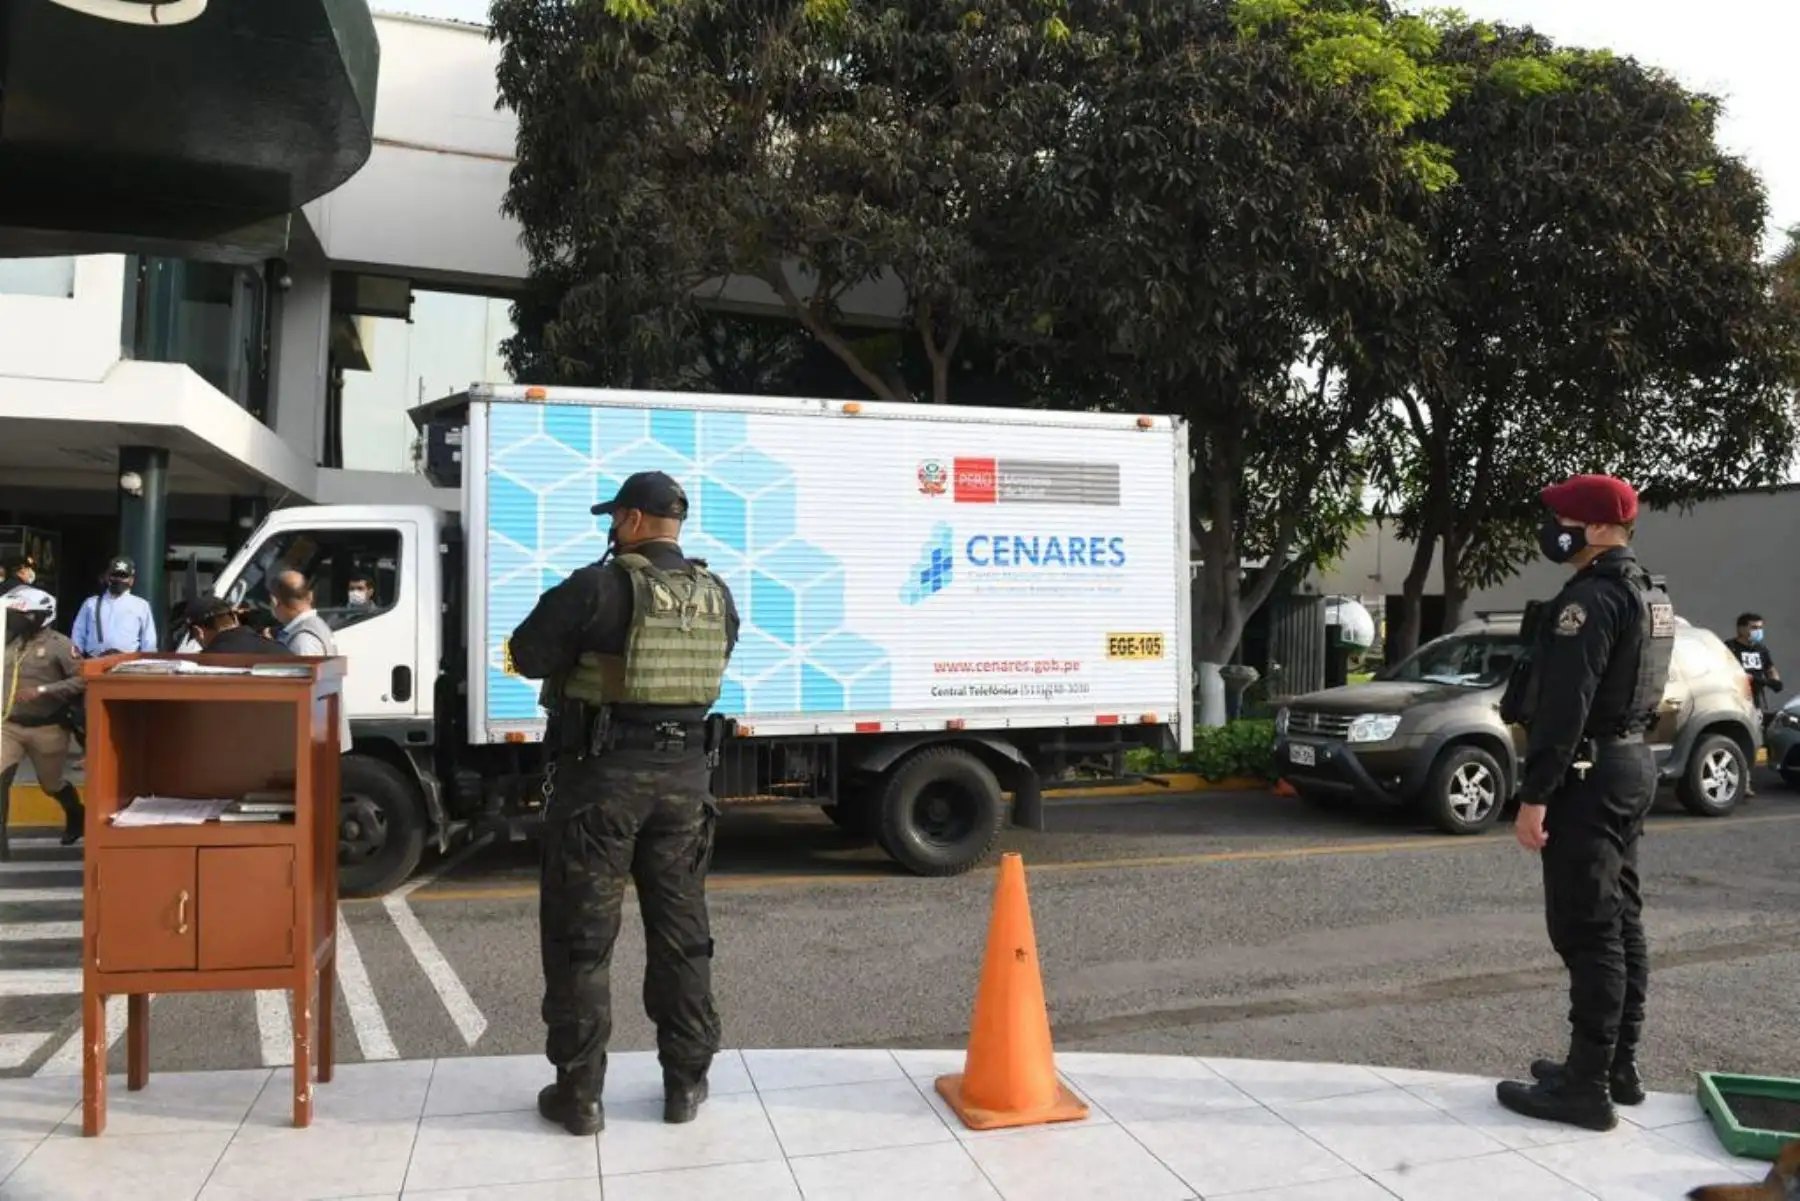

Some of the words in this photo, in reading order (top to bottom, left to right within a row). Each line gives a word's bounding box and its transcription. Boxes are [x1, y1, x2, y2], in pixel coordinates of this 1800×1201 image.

[966, 534, 1127, 568] CENARES
[1110, 637, 1161, 656] EGE-105
[934, 658, 1081, 674] www.cenares.gob.pe
[931, 684, 967, 697] Central
[969, 683, 1018, 696] Telefónica
